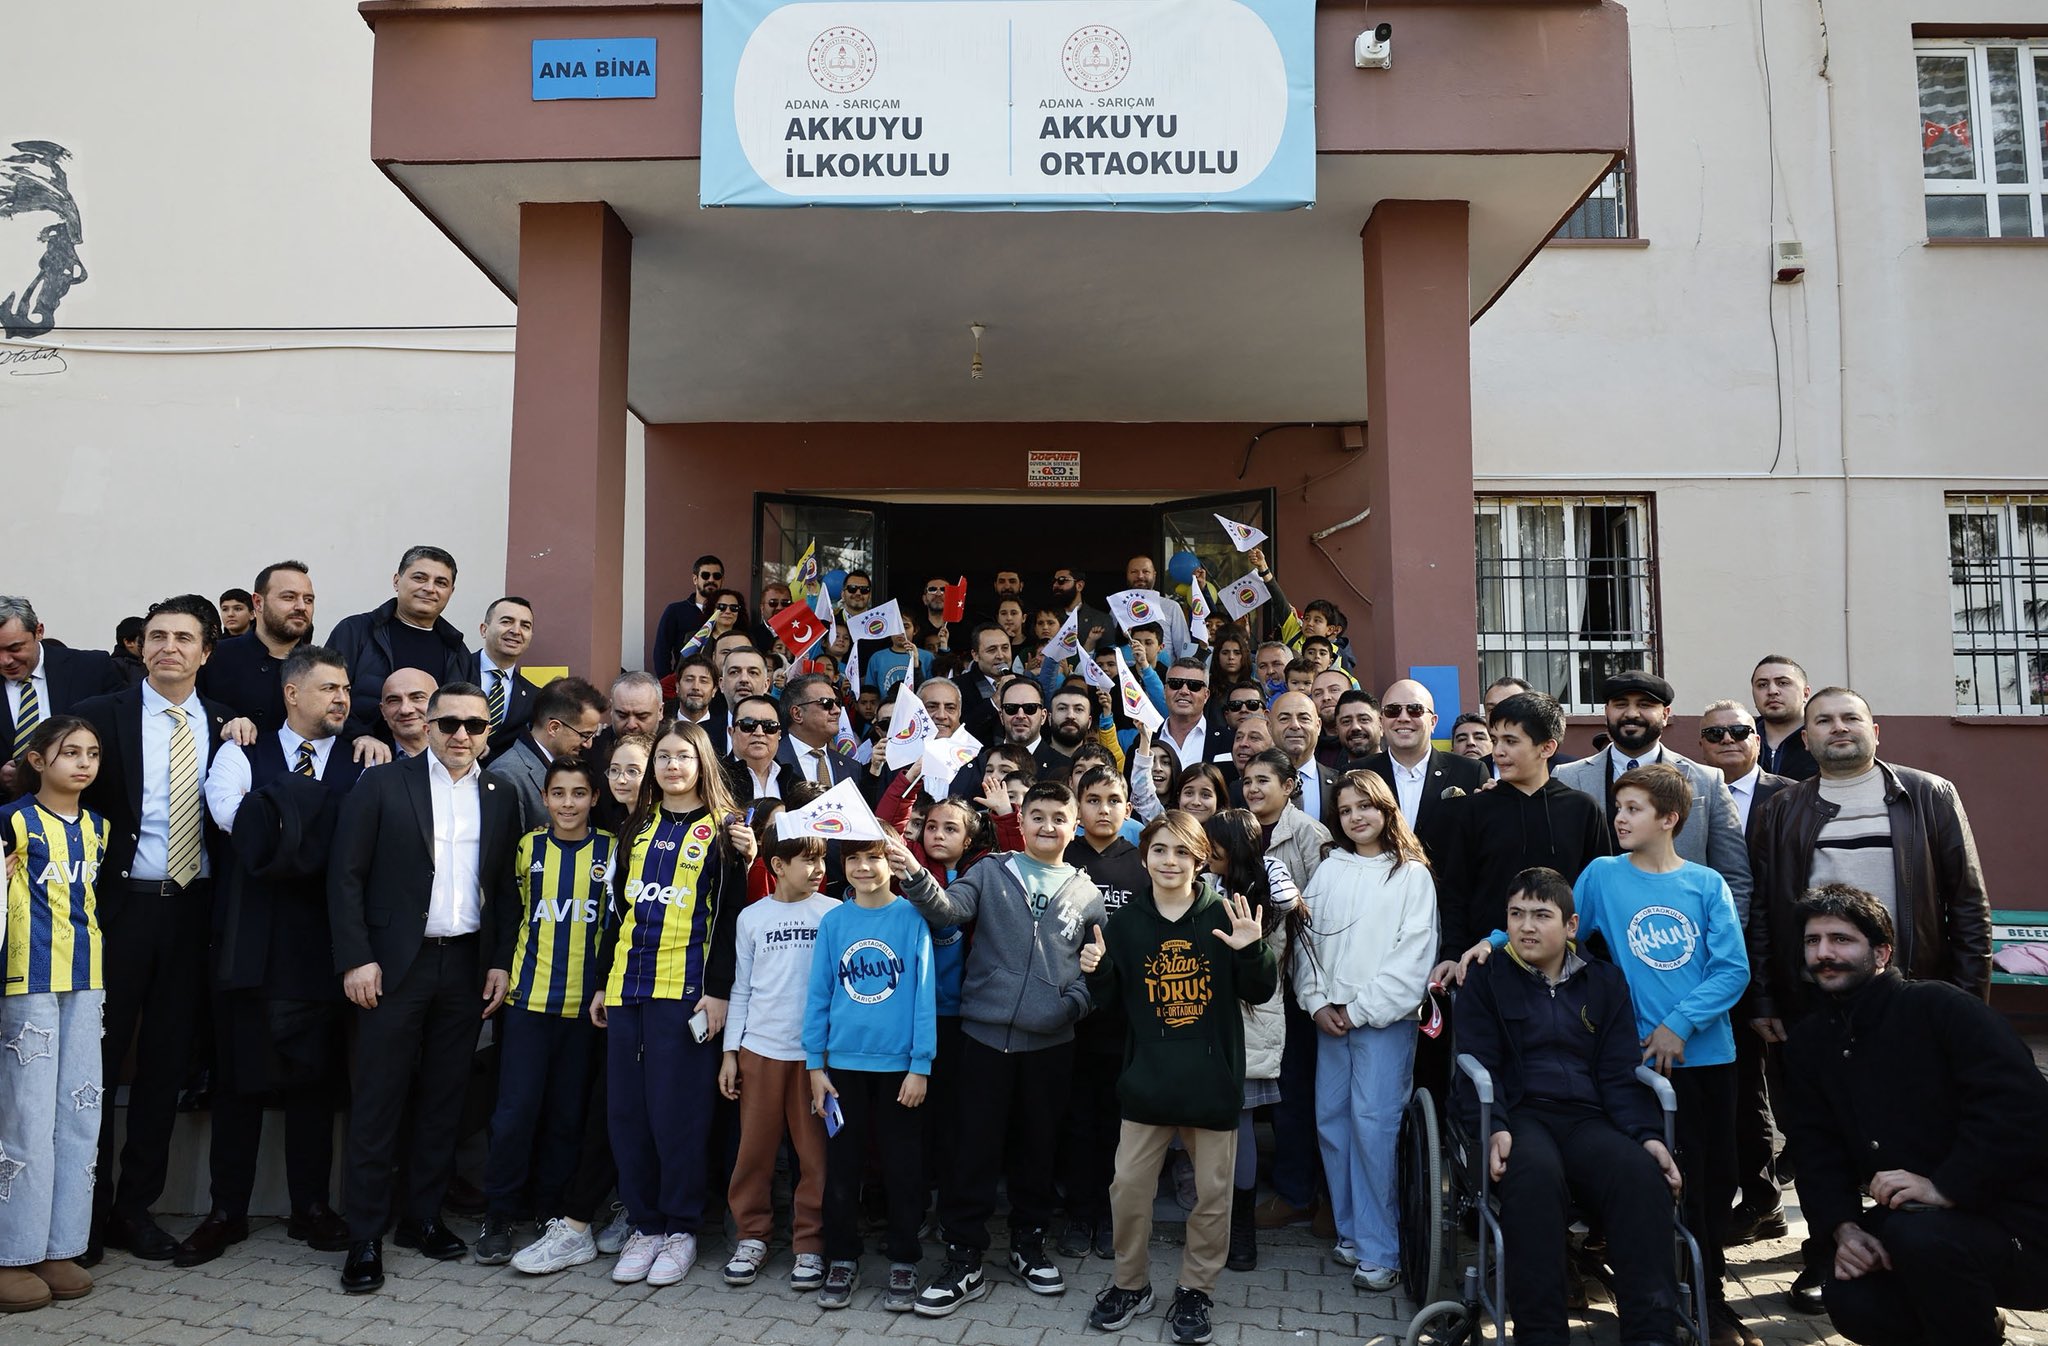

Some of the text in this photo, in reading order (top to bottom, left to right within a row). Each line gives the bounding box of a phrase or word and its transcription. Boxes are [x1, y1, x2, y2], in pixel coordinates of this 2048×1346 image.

[539, 57, 651, 79] ANA BİNA
[785, 100, 829, 110] ADANA
[843, 100, 901, 111] SARIÇAM
[1039, 98, 1083, 109] ADANA
[1097, 97, 1155, 110] SARIÇAM
[785, 116, 923, 141] AKKUYU
[1039, 114, 1178, 140] AKKUYU
[786, 147, 950, 178] İLKOKULU
[1039, 150, 1238, 176] ORTAOKULU
[36, 860, 101, 884] AVIS
[680, 862, 699, 872] opet
[626, 880, 691, 908] opet
[532, 898, 598, 923] AVIS
[766, 928, 818, 944] FASTER
[1627, 922, 1701, 957] Akkuyu
[859, 941, 893, 957] ORTAOKULU
[838, 955, 905, 990] Akkuyu
